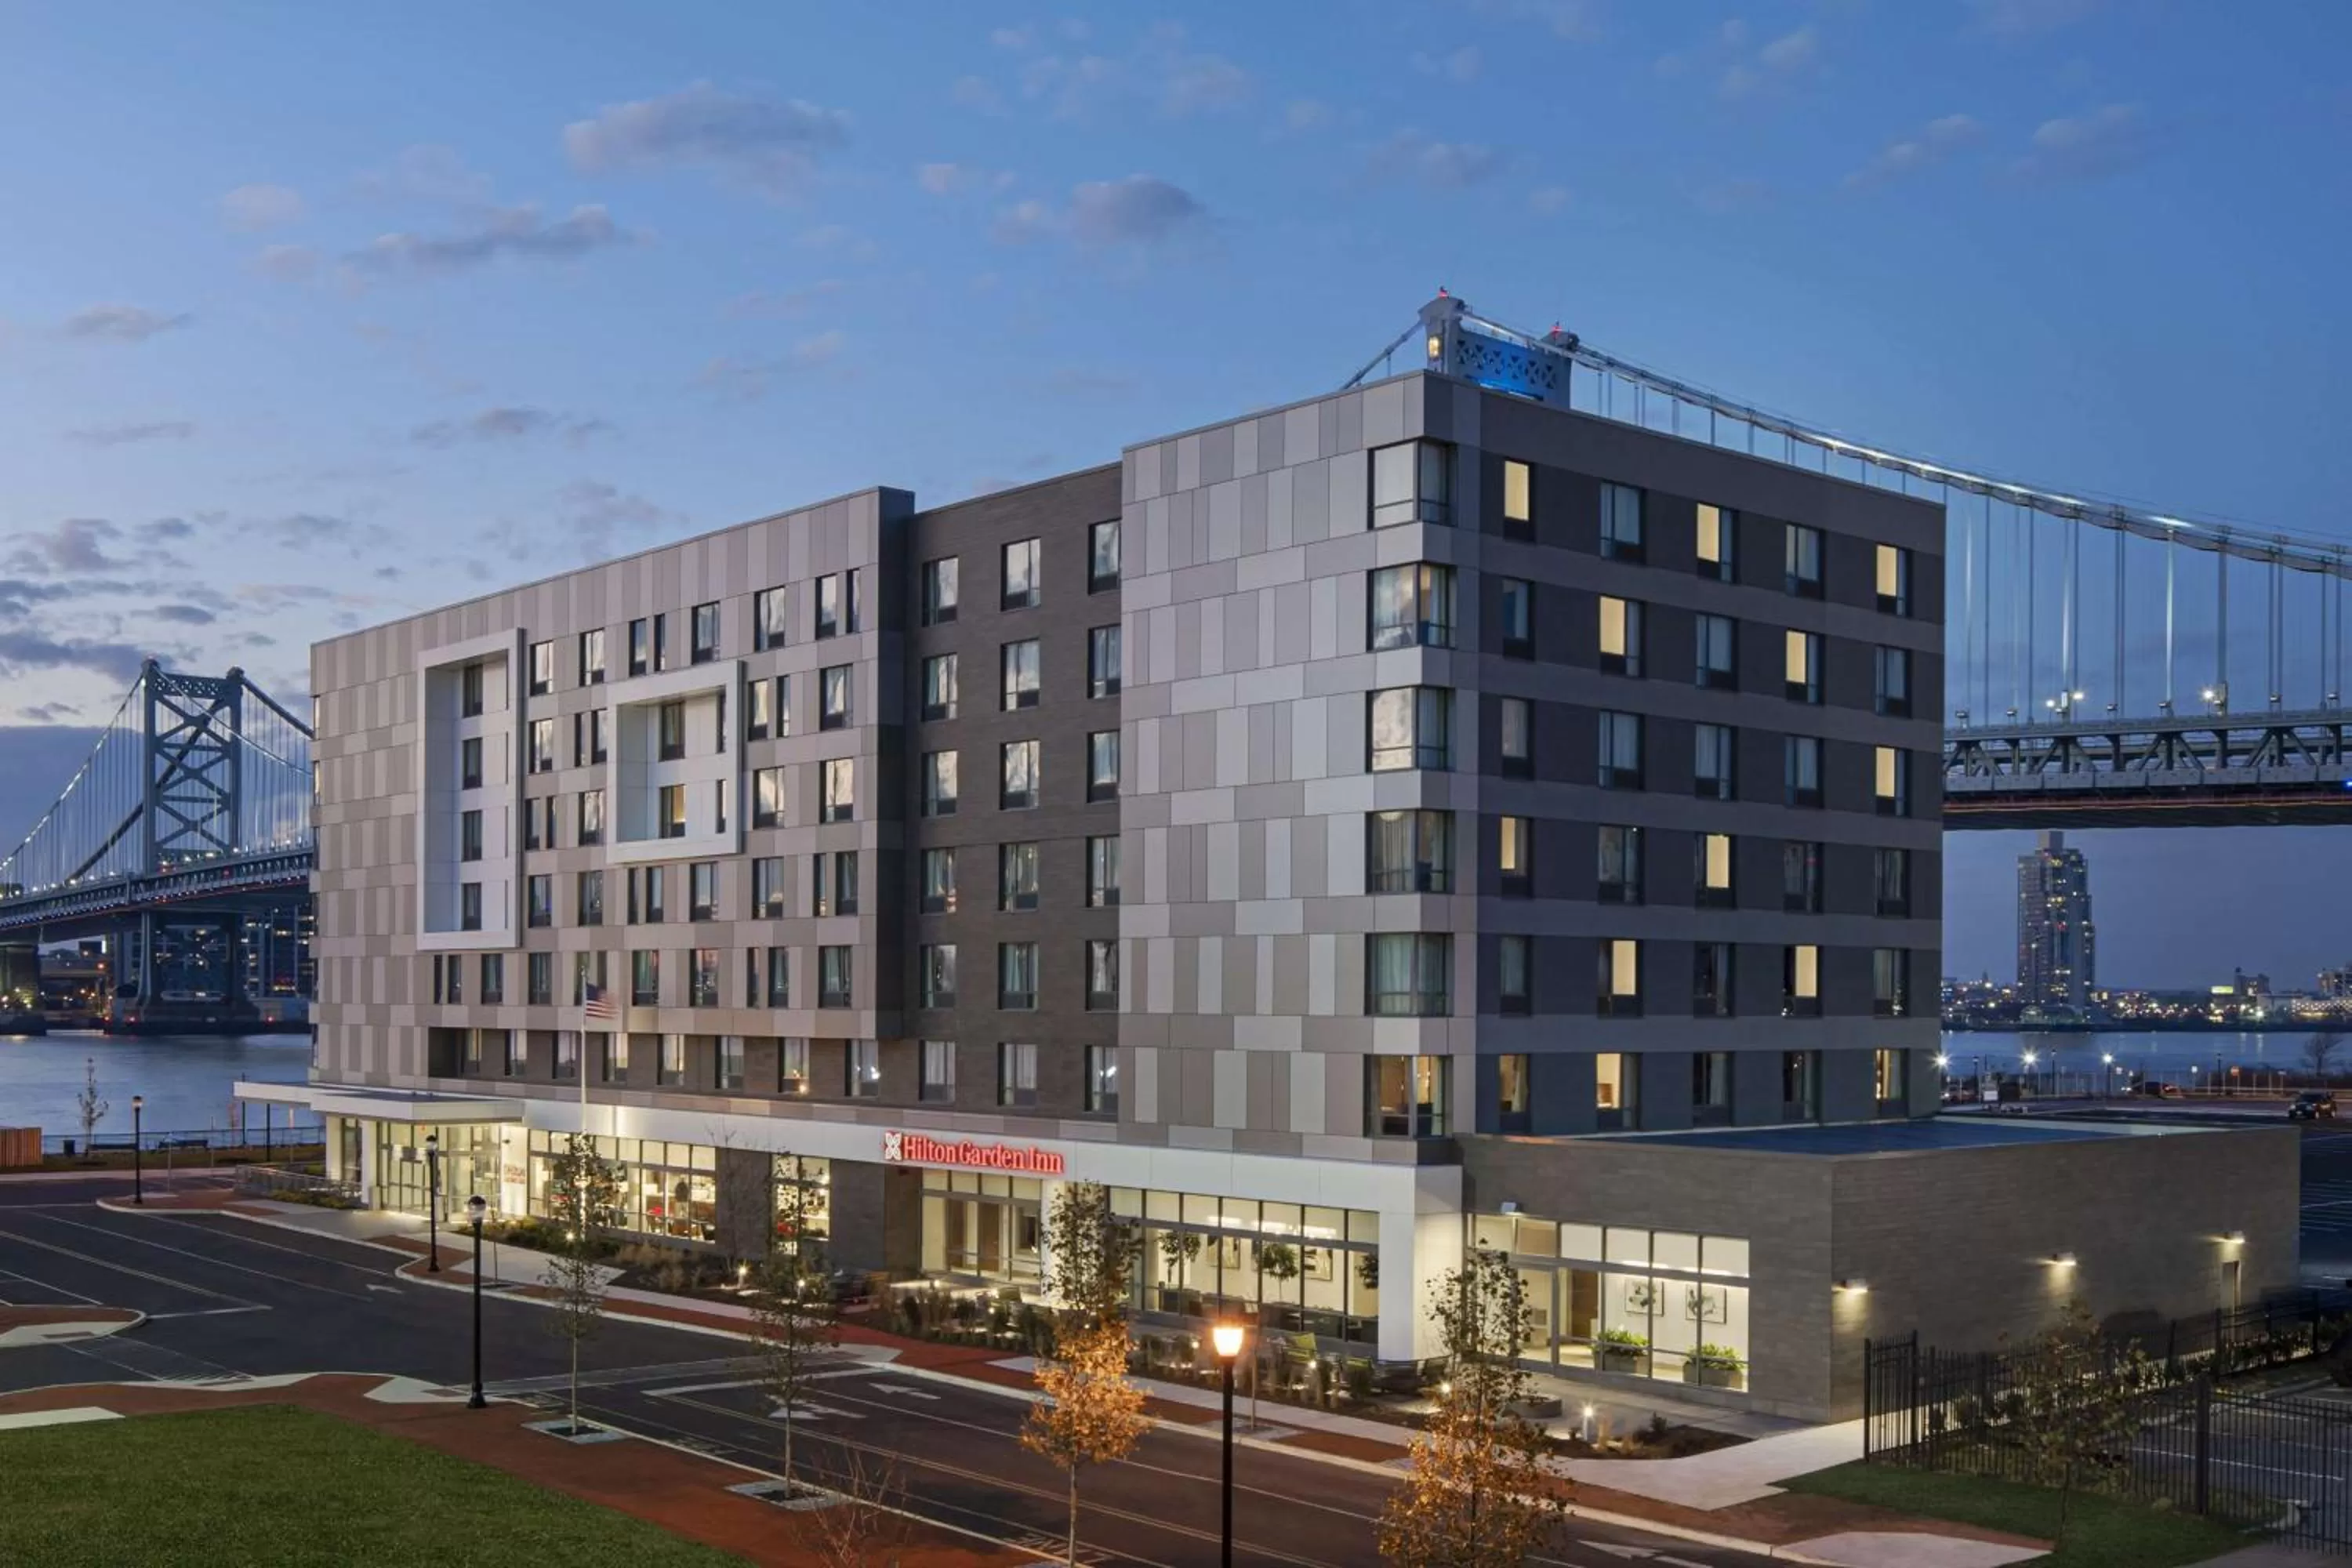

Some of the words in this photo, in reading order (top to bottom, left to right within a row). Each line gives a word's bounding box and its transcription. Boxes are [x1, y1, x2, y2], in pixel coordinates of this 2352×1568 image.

[903, 1136, 956, 1163] Hilton
[959, 1141, 1025, 1169] Garden
[1028, 1146, 1062, 1174] Inn
